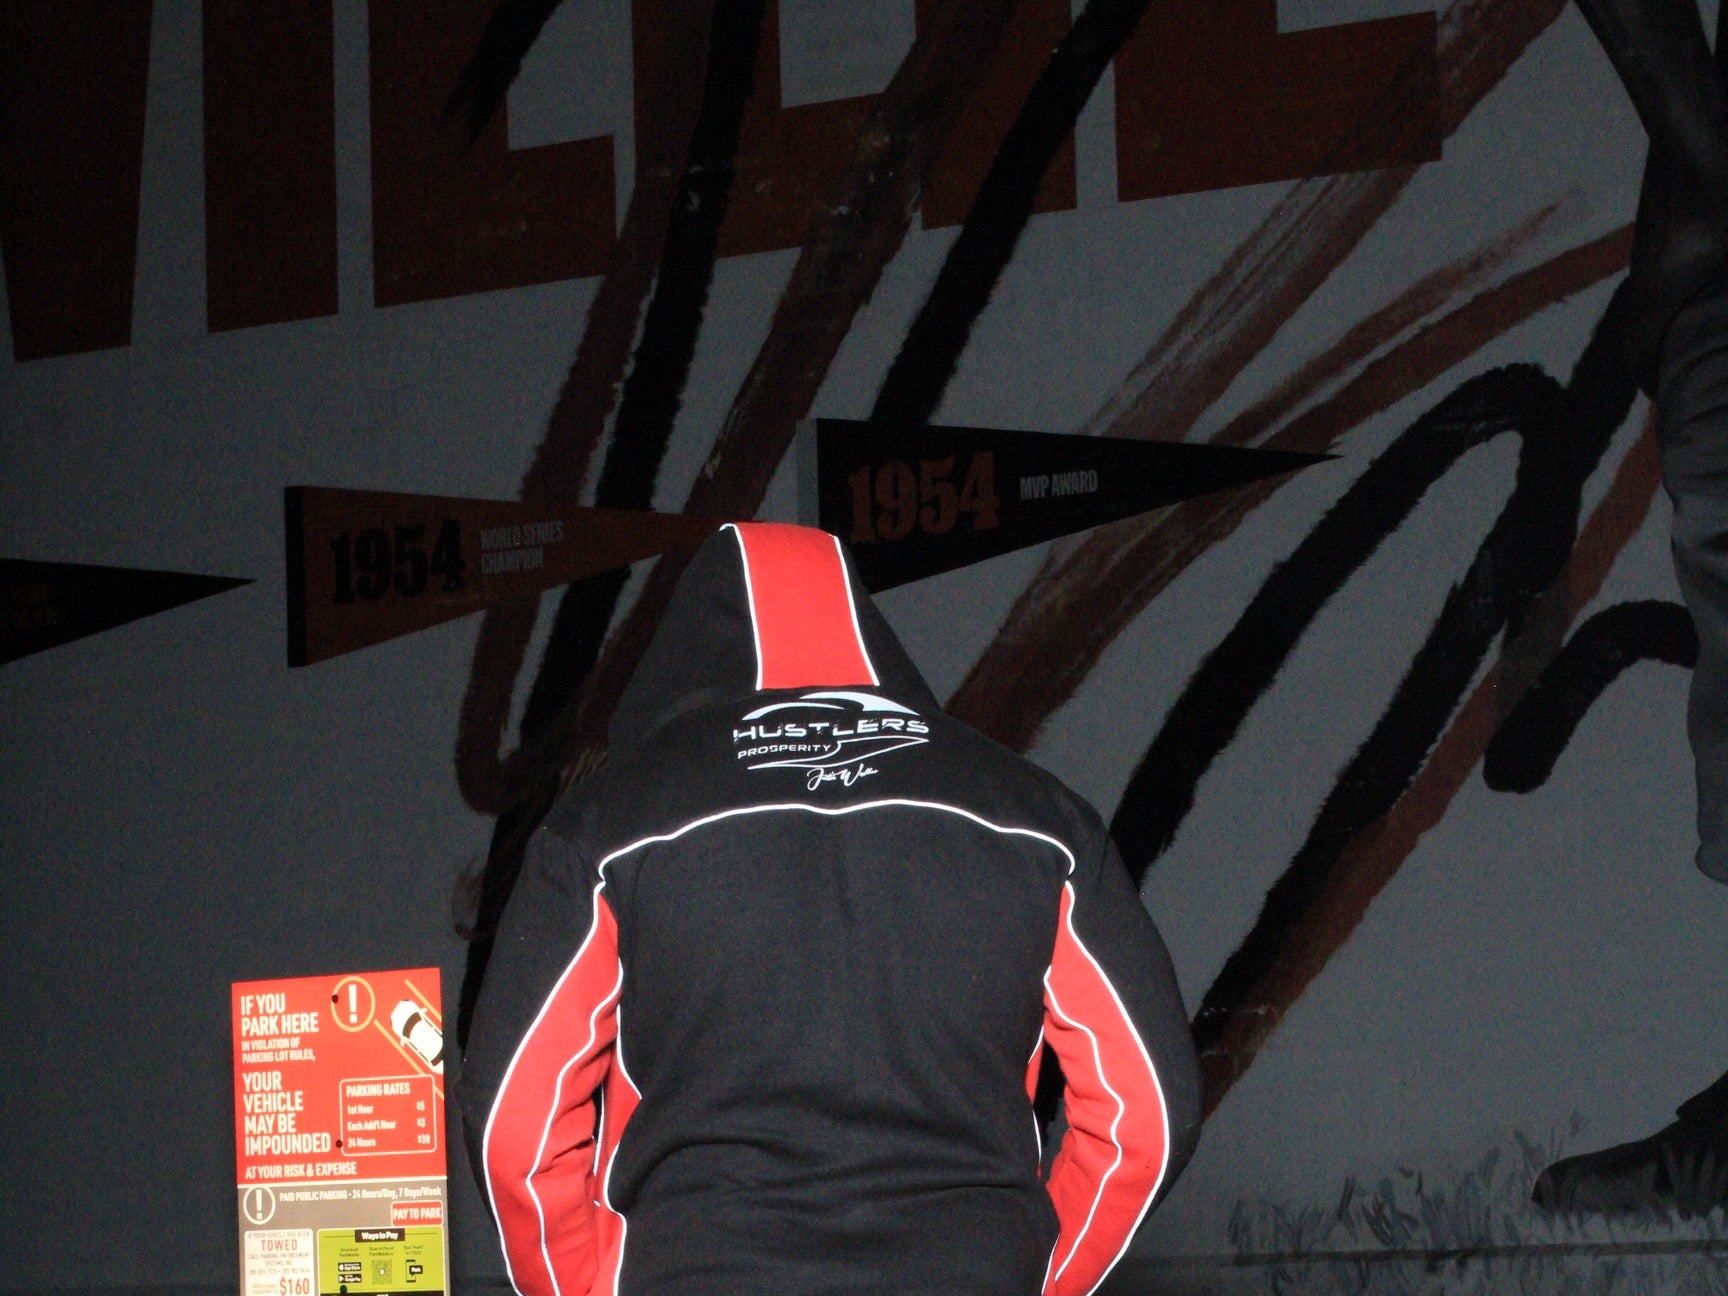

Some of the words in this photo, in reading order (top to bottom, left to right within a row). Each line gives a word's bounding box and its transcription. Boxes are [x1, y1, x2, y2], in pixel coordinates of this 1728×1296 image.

[1019, 475, 1050, 500] MVP
[1052, 468, 1099, 498] AWARD
[846, 447, 1000, 544] 1954
[480, 526, 521, 550] WORLD
[522, 520, 564, 545] SERIES
[330, 519, 467, 606] 1954
[481, 546, 544, 575] CHAMPION
[732, 718, 930, 744] HUSTLERS
[737, 744, 831, 759] PROSPERITY
[241, 995, 254, 1015] IF
[256, 992, 286, 1014] YOU
[241, 1015, 279, 1037] PARK
[281, 1012, 319, 1035] HERE
[242, 1040, 250, 1051] IN
[251, 1038, 290, 1050] VIOLATION
[290, 1037, 300, 1048] OF
[242, 1051, 274, 1063] PARKING
[275, 1050, 289, 1062] LOT
[289, 1049, 316, 1062] RULES,
[242, 1070, 282, 1092] YOUR
[346, 1083, 383, 1098] PARKING
[383, 1082, 411, 1096] RATES
[243, 1090, 304, 1113] VEHICLE
[347, 1105, 357, 1115] 1st
[357, 1104, 374, 1114] Hour
[244, 1114, 275, 1135] MAY
[277, 1113, 297, 1133] BE
[347, 1121, 363, 1131] Each
[380, 1119, 397, 1130] Hour
[245, 1132, 331, 1156] IMPOUNDED
[356, 1137, 376, 1147] Hours
[245, 1166, 256, 1179] AT
[257, 1165, 283, 1179] YOUR
[283, 1163, 306, 1178] RISK
[306, 1163, 314, 1177] &
[315, 1161, 357, 1176] EXPENSE
[279, 1192, 295, 1202] PAID
[295, 1191, 319, 1201] PUBLIC
[319, 1189, 348, 1201] PARKING
[352, 1189, 361, 1200] 24
[393, 1208, 408, 1220] PAY
[408, 1207, 419, 1220] TO
[420, 1207, 441, 1219] PARK
[261, 1239, 297, 1251] TOWED
[361, 1231, 379, 1241] Ways
[379, 1231, 385, 1239] to
[385, 1231, 399, 1240] Pay
